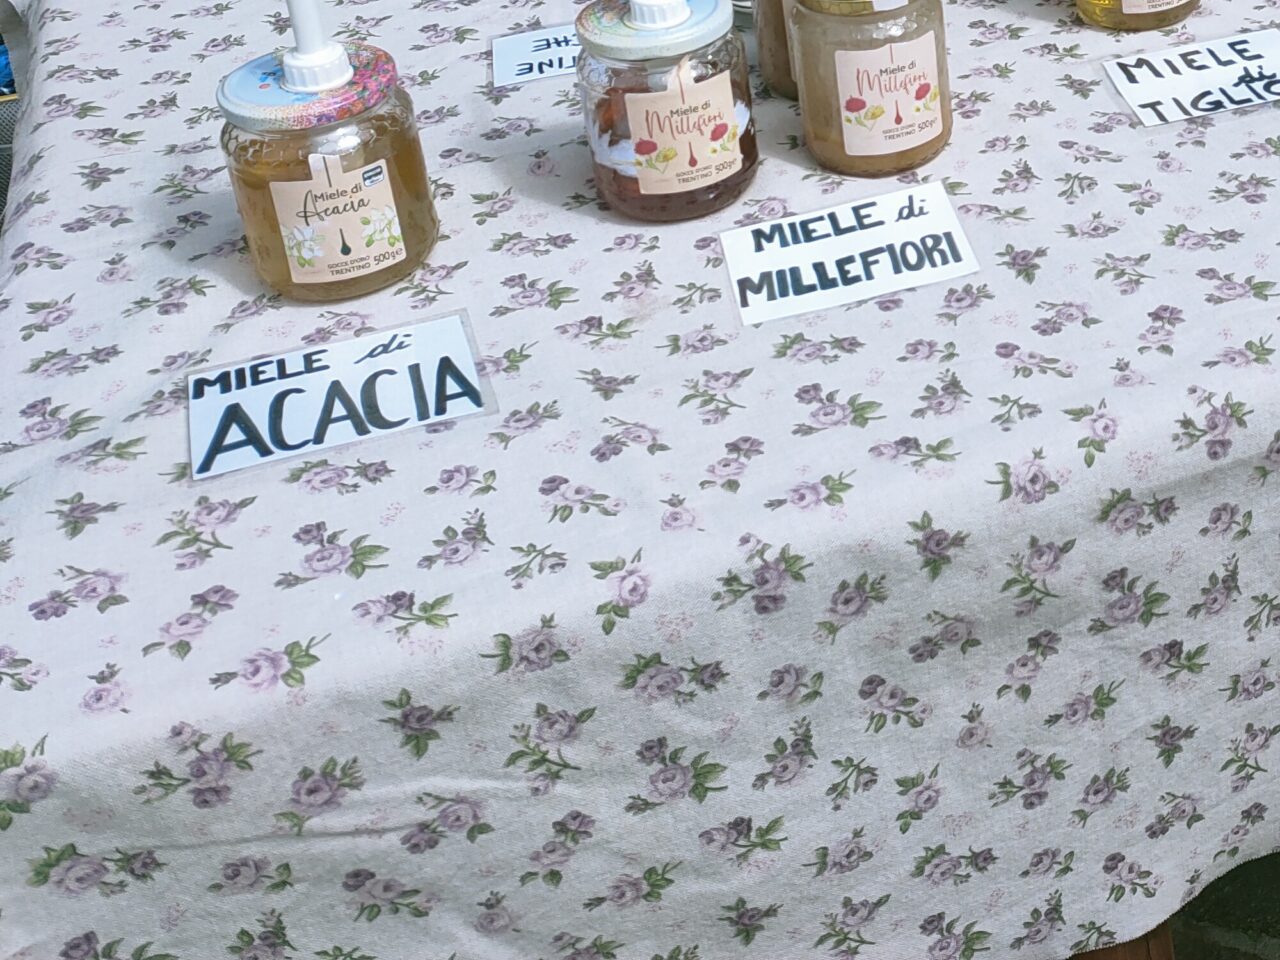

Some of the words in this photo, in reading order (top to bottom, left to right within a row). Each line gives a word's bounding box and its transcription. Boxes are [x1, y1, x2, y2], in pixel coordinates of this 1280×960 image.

[880, 65, 906, 76] Miele
[908, 60, 916, 69] di
[1116, 39, 1265, 84] MIELE
[1233, 65, 1277, 87] di
[857, 68, 928, 98] Millefiori
[645, 109, 724, 141] Millefiori
[670, 105, 699, 118] Miele
[701, 100, 711, 111] di
[296, 189, 371, 227] Acacia
[314, 187, 348, 202] Miele
[350, 183, 363, 194] di
[751, 201, 885, 253] MIELE
[895, 195, 929, 222] di
[330, 262, 371, 276] TRENTINO
[737, 231, 962, 308] MILLEFIORI
[192, 349, 330, 400] MIELE
[353, 334, 412, 364] di
[196, 356, 483, 474] ACACIA
